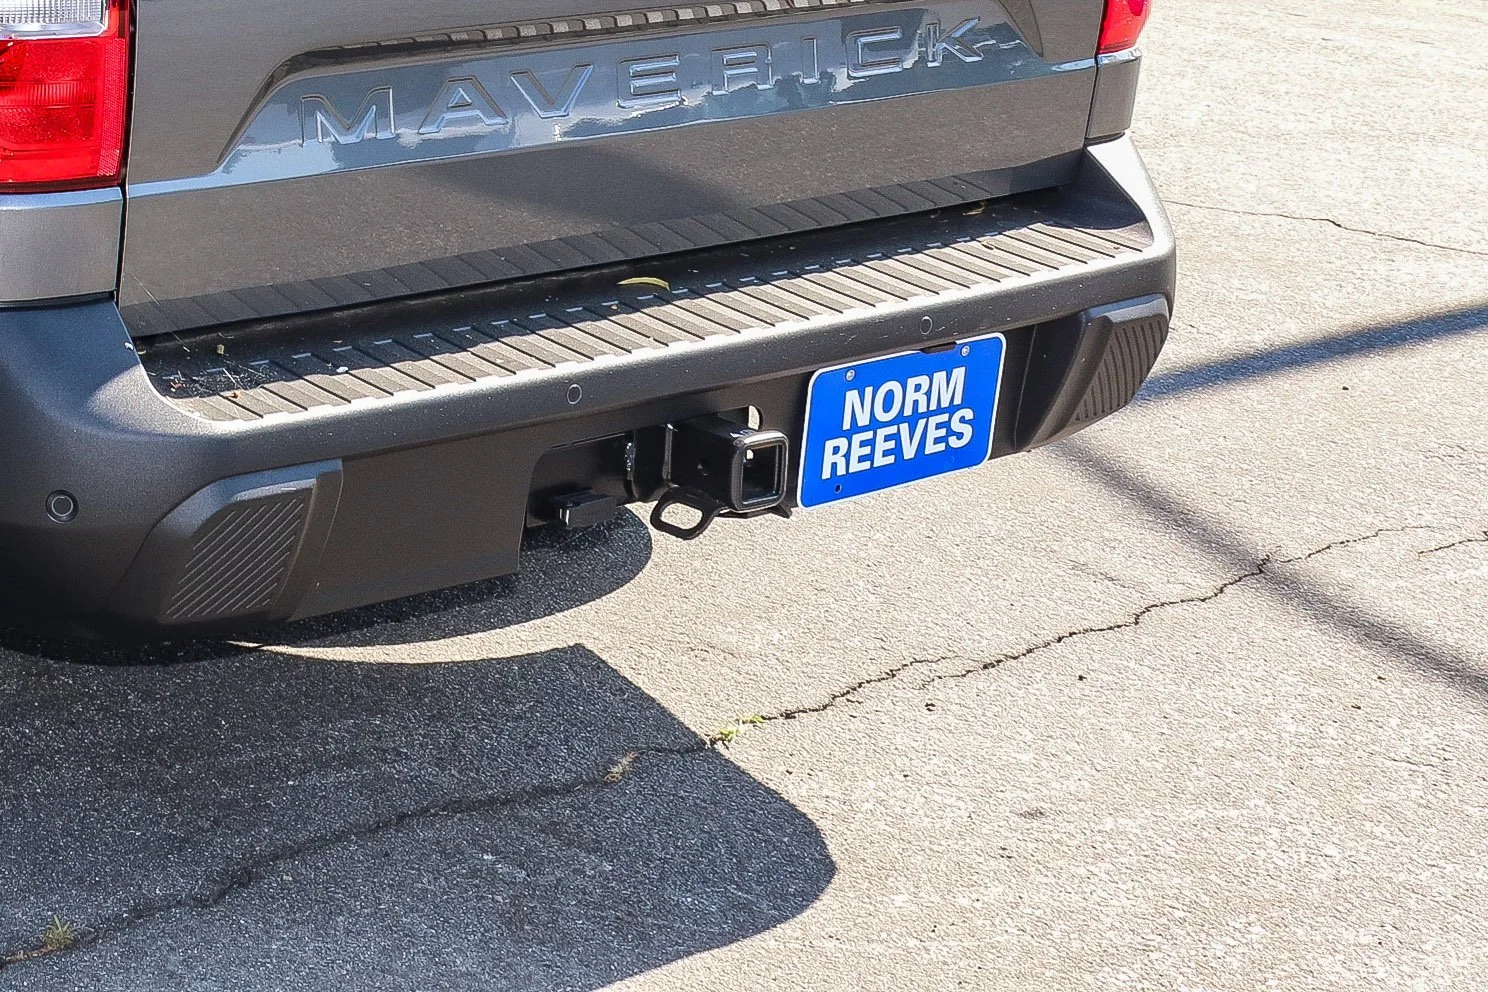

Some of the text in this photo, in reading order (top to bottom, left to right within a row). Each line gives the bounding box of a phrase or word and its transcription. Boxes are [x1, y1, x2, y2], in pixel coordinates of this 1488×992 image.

[298, 16, 984, 148] MAVERICK
[842, 366, 967, 431] NORM
[821, 408, 975, 480] REEVES
